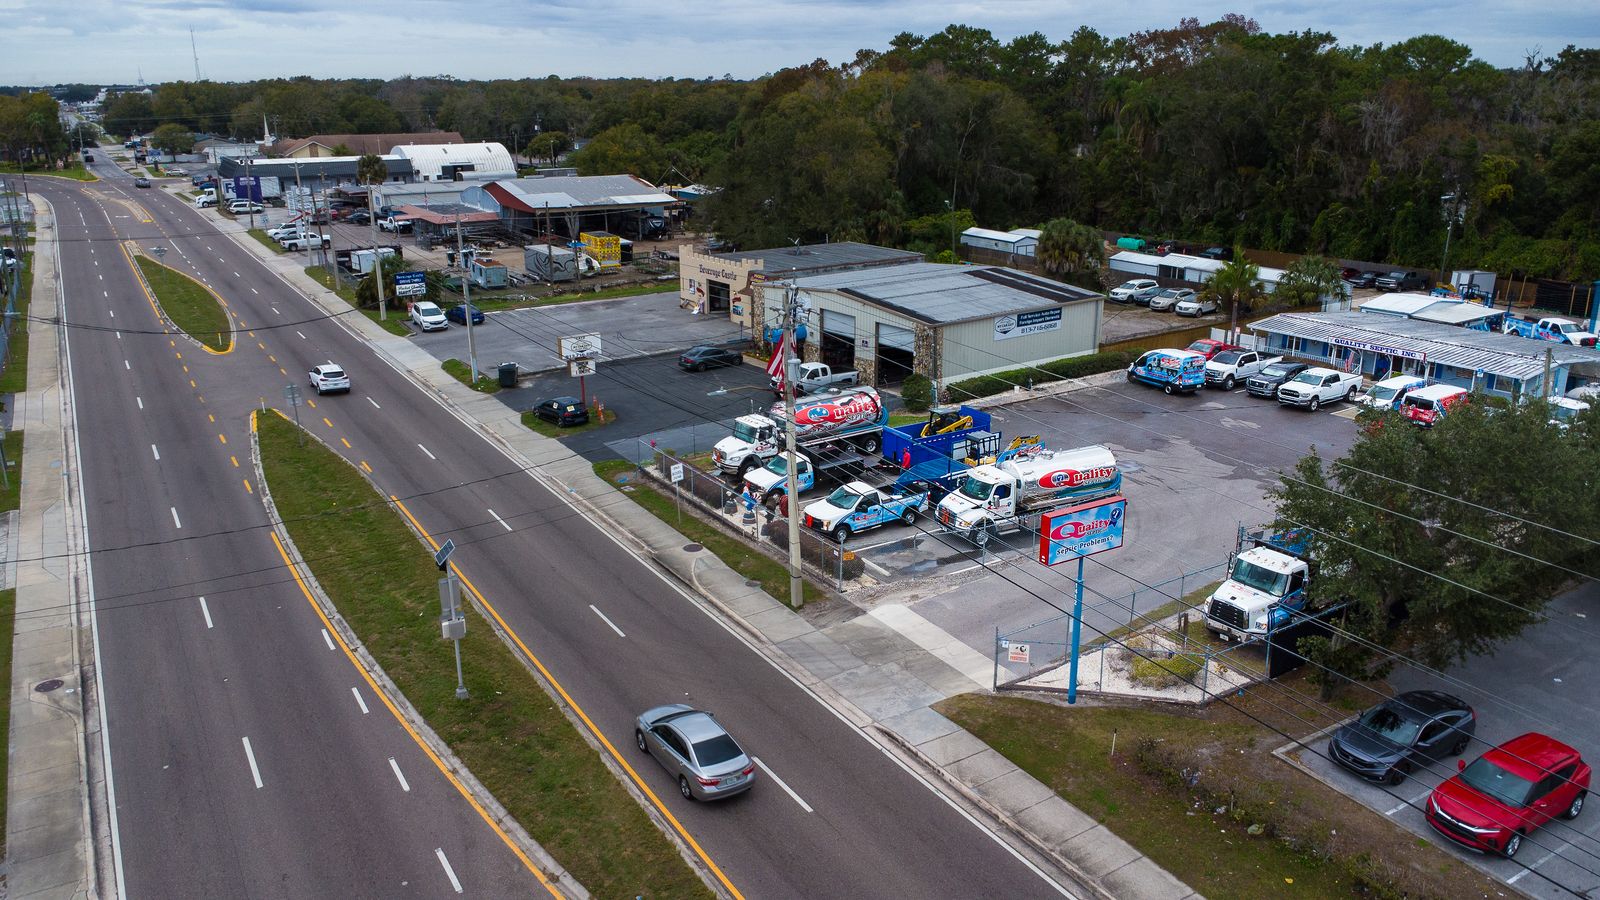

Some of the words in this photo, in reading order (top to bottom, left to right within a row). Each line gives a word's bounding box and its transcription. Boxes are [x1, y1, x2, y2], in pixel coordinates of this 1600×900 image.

[699, 264, 721, 279] Beverage
[721, 268, 737, 280] Castle
[1334, 338, 1367, 349] QUALITY
[794, 399, 878, 425] Quality
[1038, 467, 1114, 489] Quality
[1050, 519, 1110, 541] Quality
[1056, 544, 1078, 556] Septic
[1079, 534, 1114, 550] Problems?
